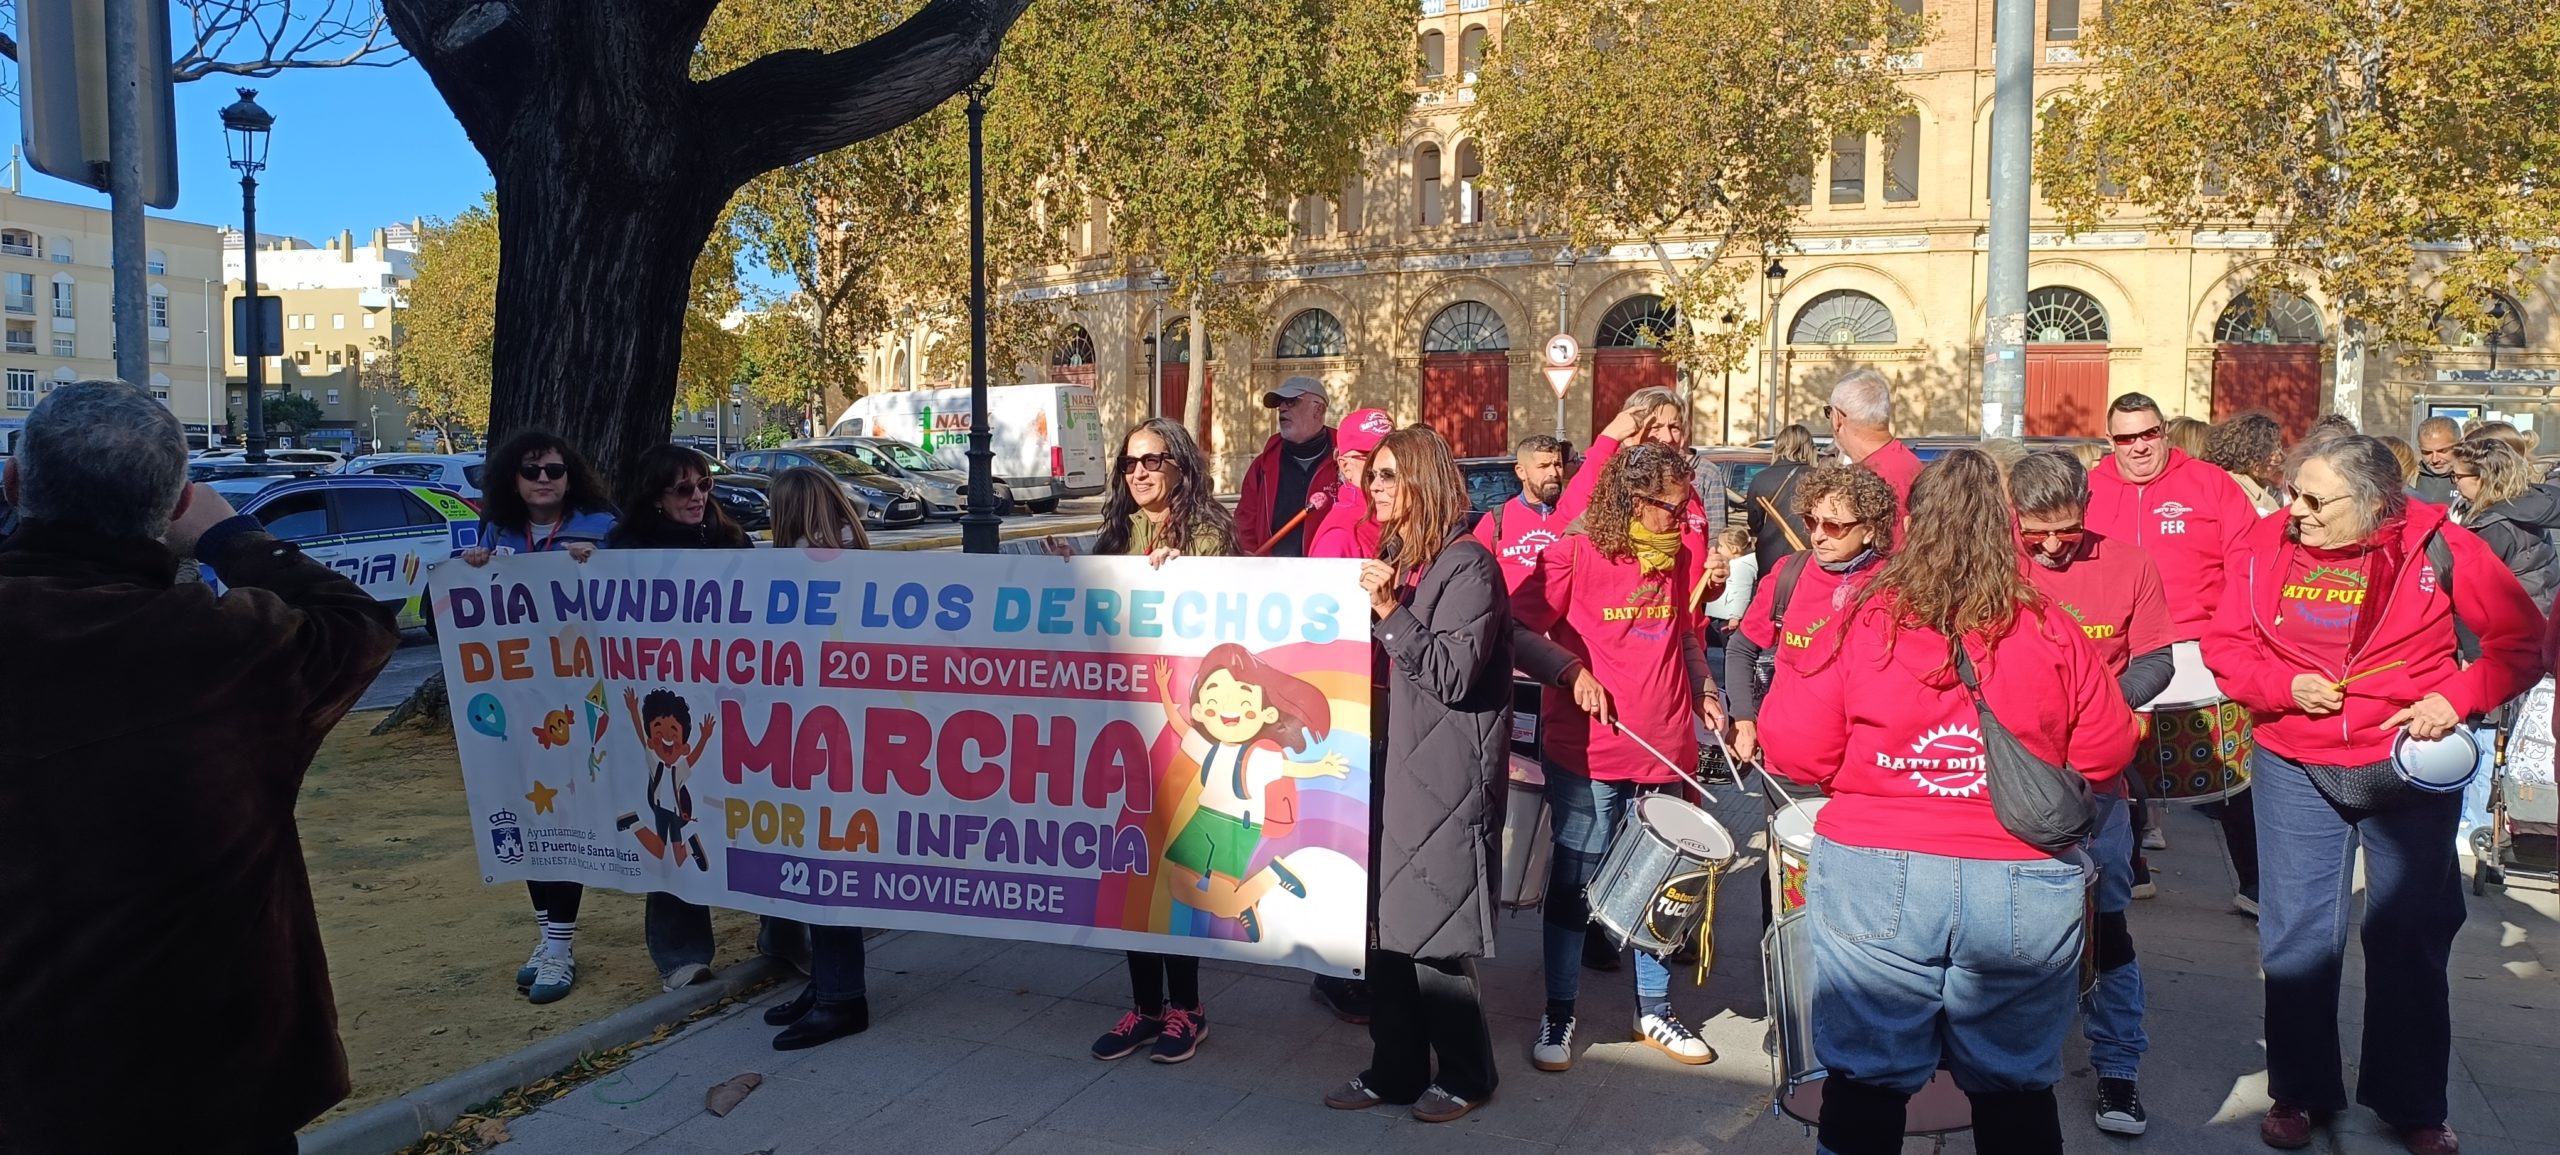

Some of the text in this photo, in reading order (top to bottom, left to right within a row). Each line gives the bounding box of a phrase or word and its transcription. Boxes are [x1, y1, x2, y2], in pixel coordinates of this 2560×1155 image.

[1836, 330, 1848, 341] 13
[2046, 329, 2059, 341] 14
[2259, 329, 2271, 341] 15
[935, 412, 994, 429] NAC
[2161, 520, 2186, 535] FER
[2325, 589, 2367, 605] PUE
[449, 573, 1341, 644] DÍA MUNDIAL DE LOS DERECHOS
[1646, 604, 1678, 619] PUE
[1785, 631, 1814, 649] BAT
[2080, 624, 2114, 639] RTO
[459, 636, 805, 687] DE LA INFANCIA
[828, 650, 1149, 694] 20 DE NOVIEMBRE
[721, 699, 1153, 813] MARCHA
[1876, 751, 1987, 771] BATU PUE
[587, 829, 597, 841] de
[724, 797, 1149, 876] POR LA INFANCIA
[528, 841, 539, 852] El
[541, 841, 577, 853] Puerto
[587, 844, 616, 858] Santa
[600, 862, 606, 871] Y
[780, 861, 1065, 914] 22 DE NOVIEMBRE
